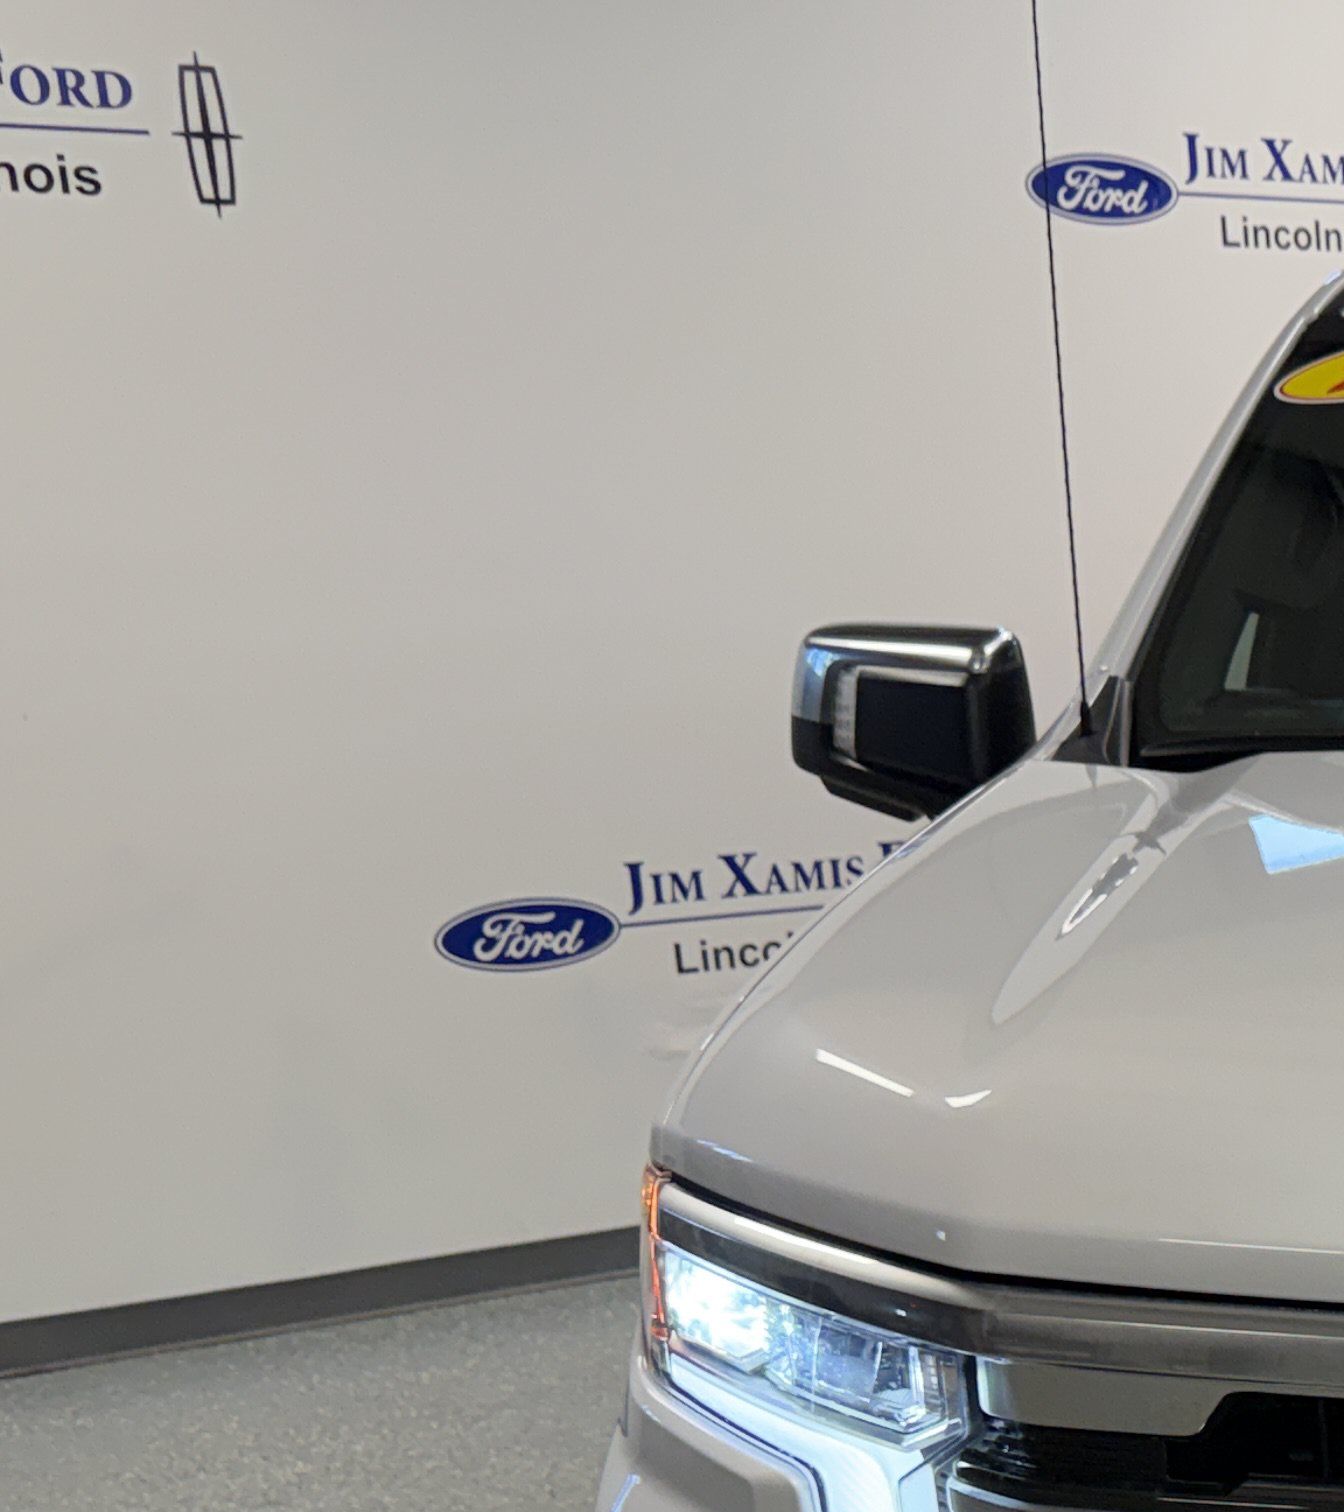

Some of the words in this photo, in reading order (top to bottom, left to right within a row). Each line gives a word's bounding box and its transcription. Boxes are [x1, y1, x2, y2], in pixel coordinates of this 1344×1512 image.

[0, 54, 132, 109] ORD
[1182, 132, 1249, 185] JIM
[1059, 165, 1150, 215] Ford
[622, 860, 704, 916] JIM
[717, 852, 864, 899] XAMIS
[473, 911, 585, 962] Ford
[673, 930, 794, 975] Linc
